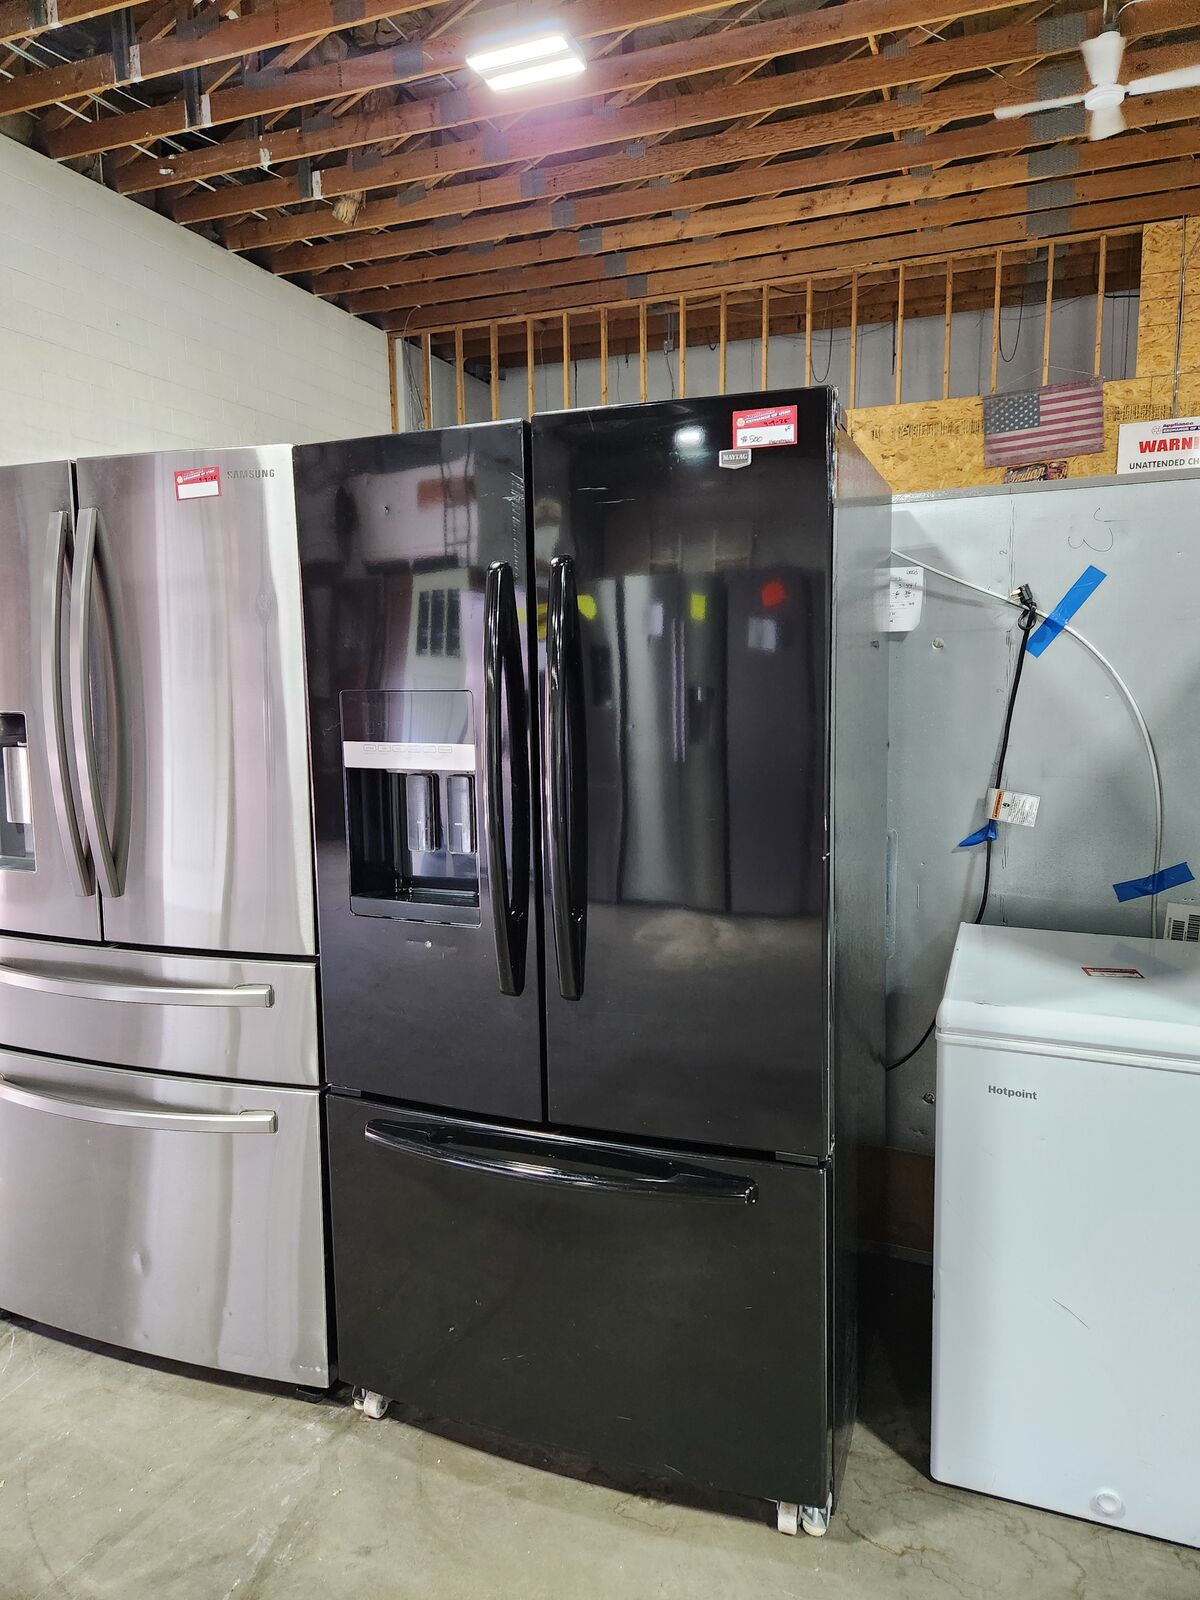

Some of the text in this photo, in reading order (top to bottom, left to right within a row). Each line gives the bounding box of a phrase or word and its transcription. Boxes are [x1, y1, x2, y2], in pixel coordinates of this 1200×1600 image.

[1162, 421, 1194, 429] Appliance
[722, 453, 748, 461] MAYTAG
[1129, 459, 1186, 470] UNATTENDED
[227, 469, 275, 479] SAMSUNG
[988, 1085, 1037, 1100] Hotpoint
